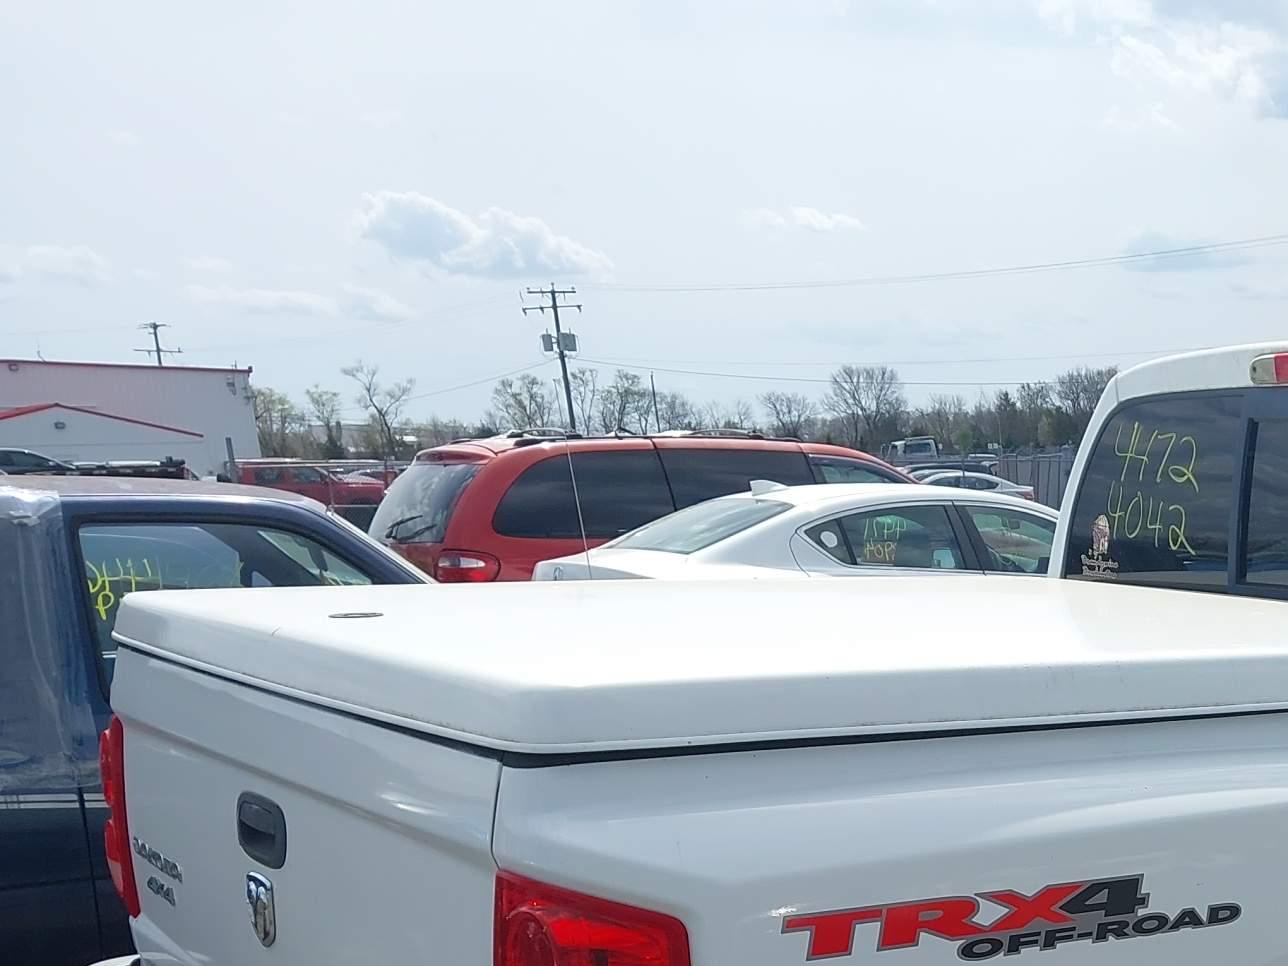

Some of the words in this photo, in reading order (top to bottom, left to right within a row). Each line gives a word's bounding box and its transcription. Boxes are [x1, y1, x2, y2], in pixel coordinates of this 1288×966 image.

[1112, 420, 1200, 494] 4472
[1106, 478, 1199, 557] 4042
[782, 873, 1150, 961] TRX4
[957, 901, 1243, 963] OFF-ROAD
